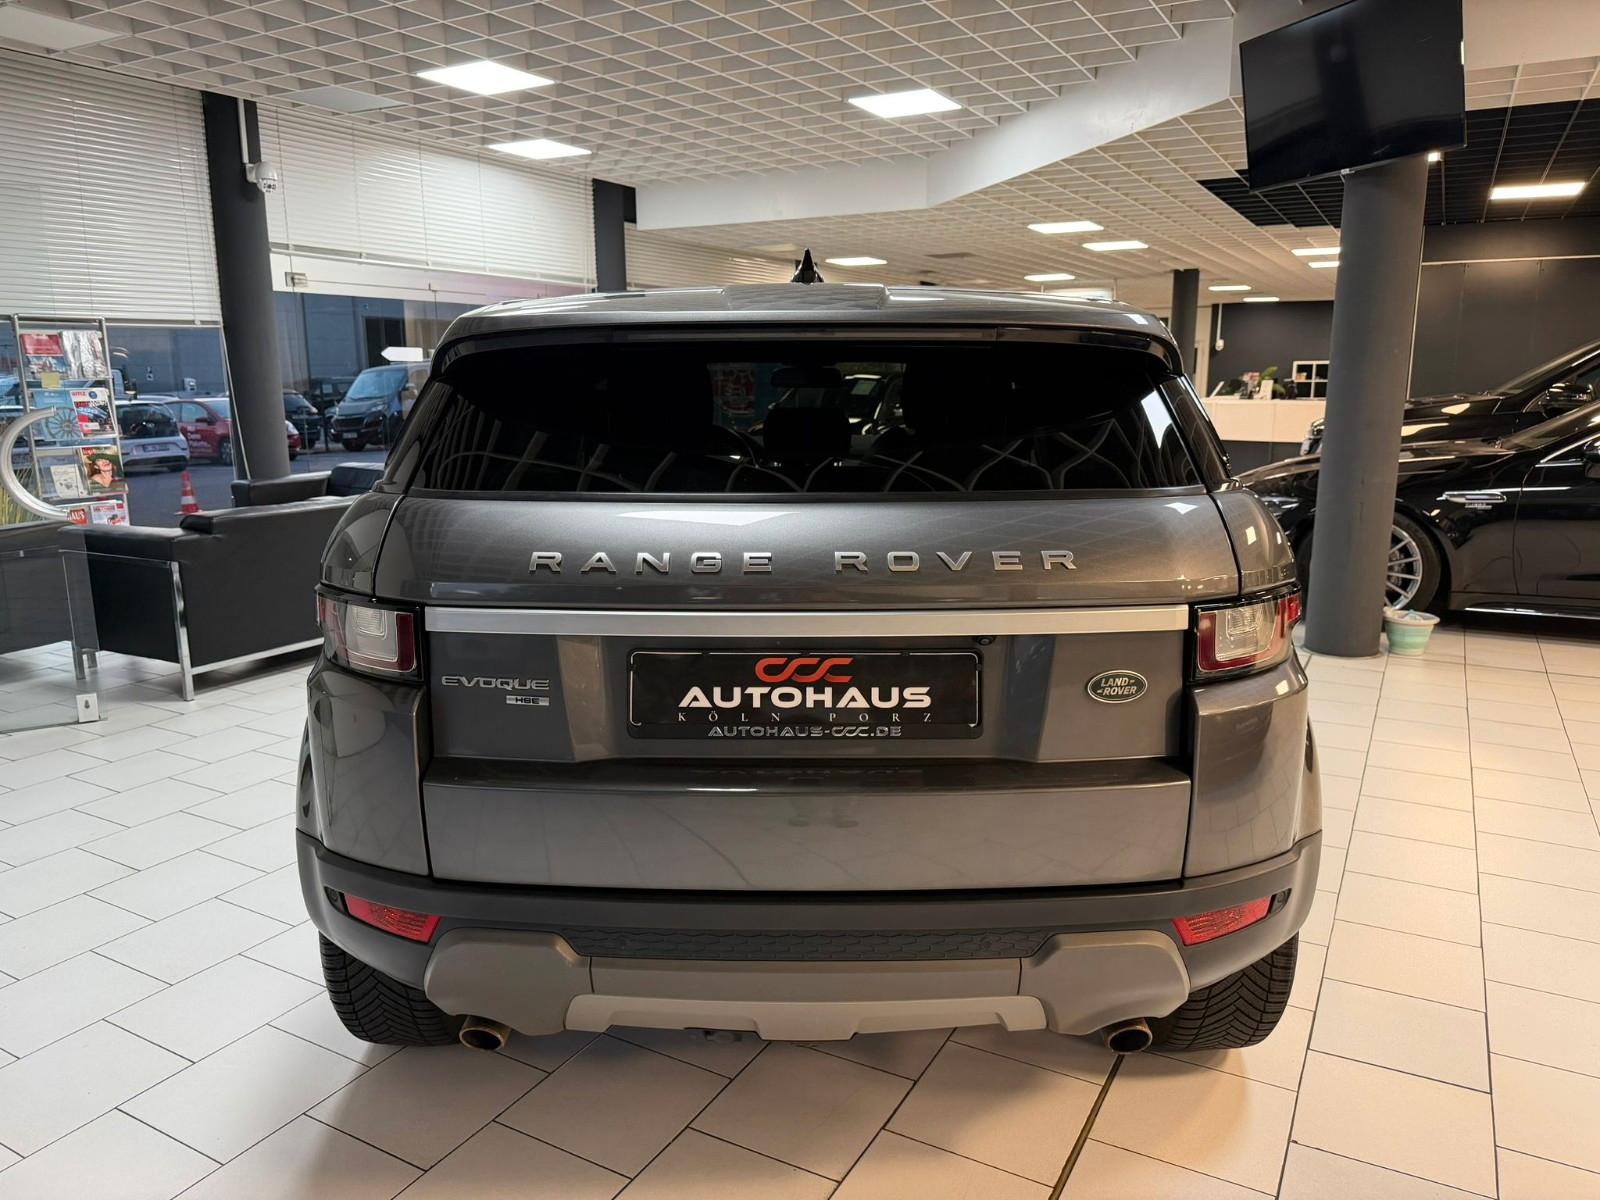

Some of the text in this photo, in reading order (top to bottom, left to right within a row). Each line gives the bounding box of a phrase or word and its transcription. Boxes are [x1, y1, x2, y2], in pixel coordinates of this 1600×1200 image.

[528, 549, 1078, 574] RANGE ROVER
[441, 675, 550, 690] EVOQUE
[1101, 678, 1129, 687] LAND
[1103, 686, 1137, 696] ROVER
[515, 696, 540, 704] HSE
[678, 686, 932, 708] AUTOHAUS
[678, 711, 931, 722] KÖLN PORZ
